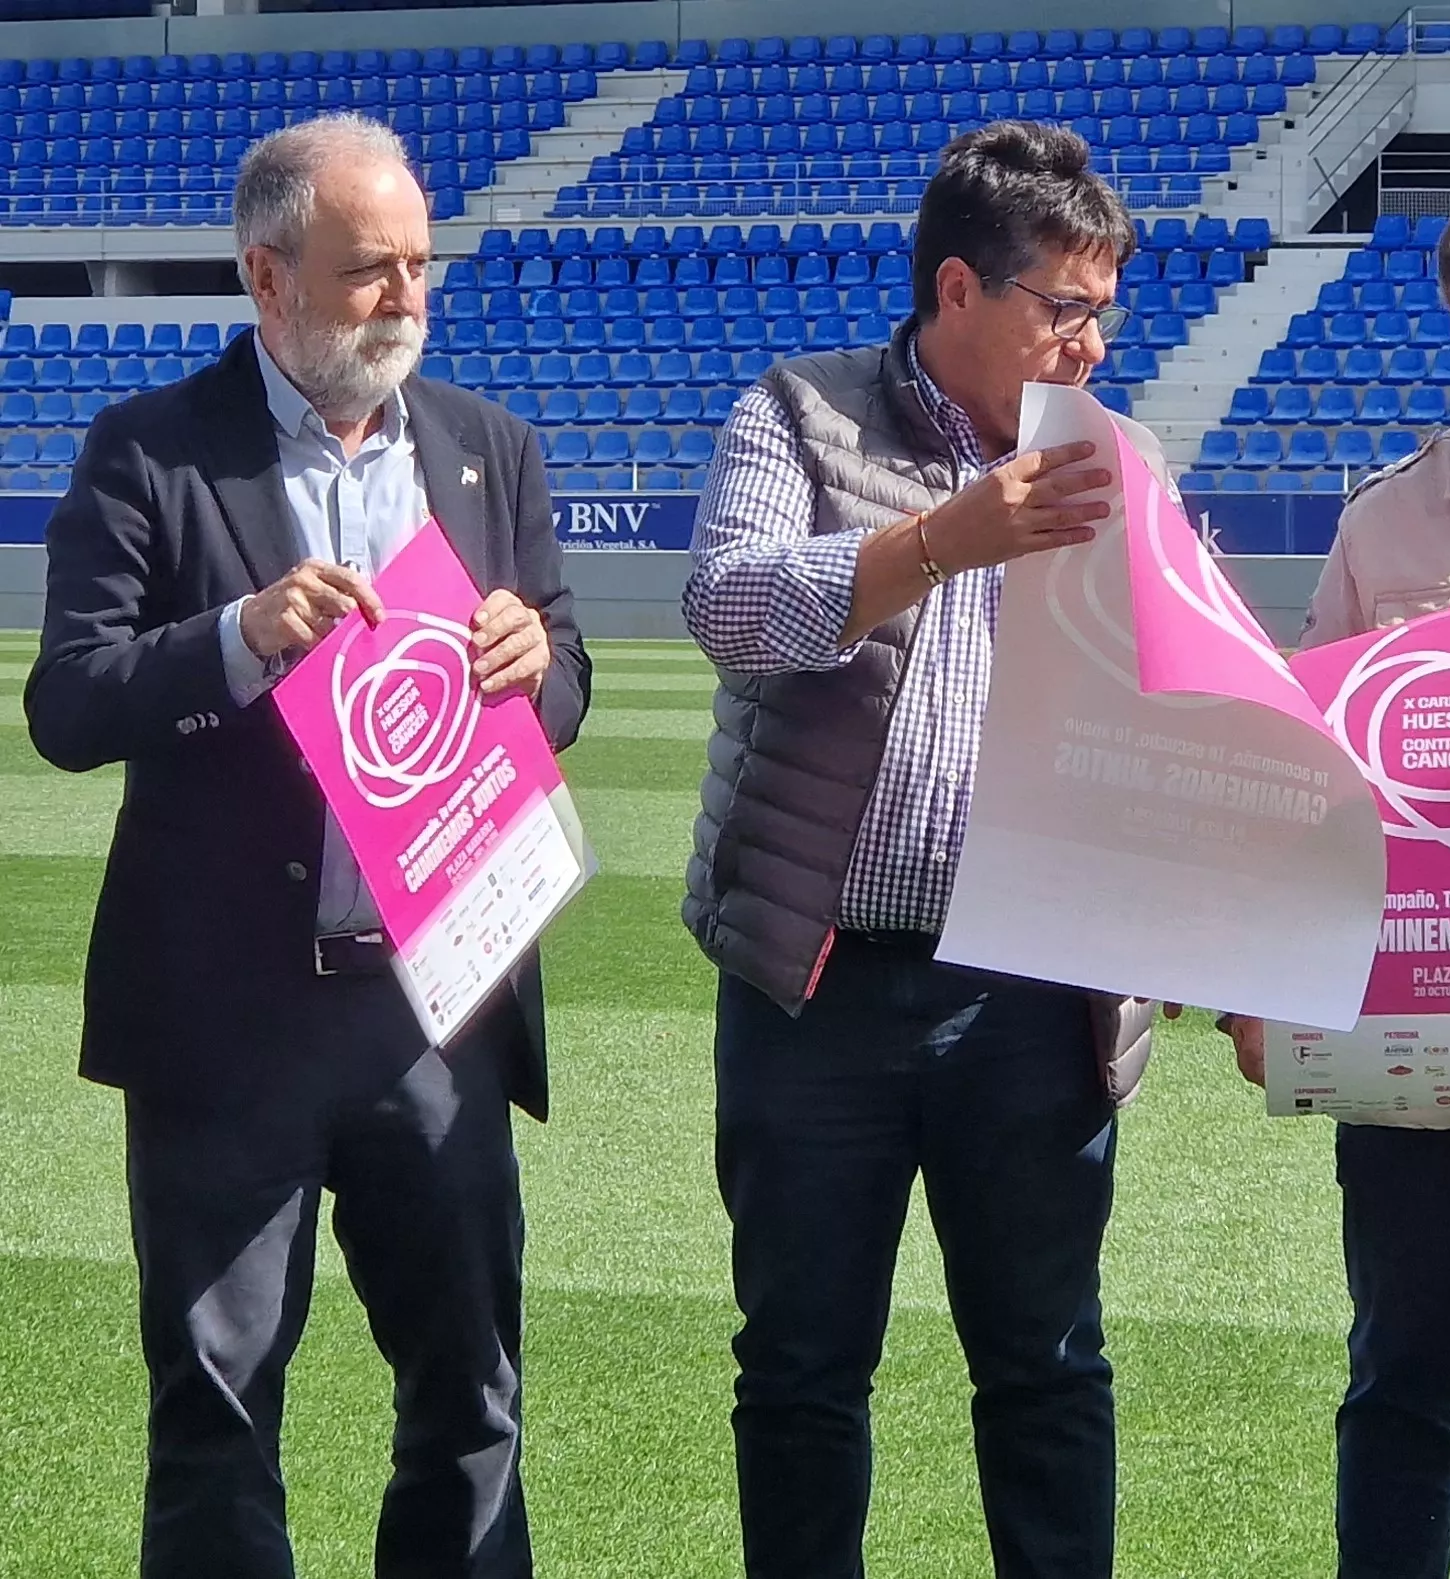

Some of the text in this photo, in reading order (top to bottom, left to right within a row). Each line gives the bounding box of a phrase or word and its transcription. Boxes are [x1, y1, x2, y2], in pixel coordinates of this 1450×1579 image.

[568, 503, 650, 533] BNV
[1403, 697, 1416, 709] X
[471, 758, 516, 817] JUNTOS
